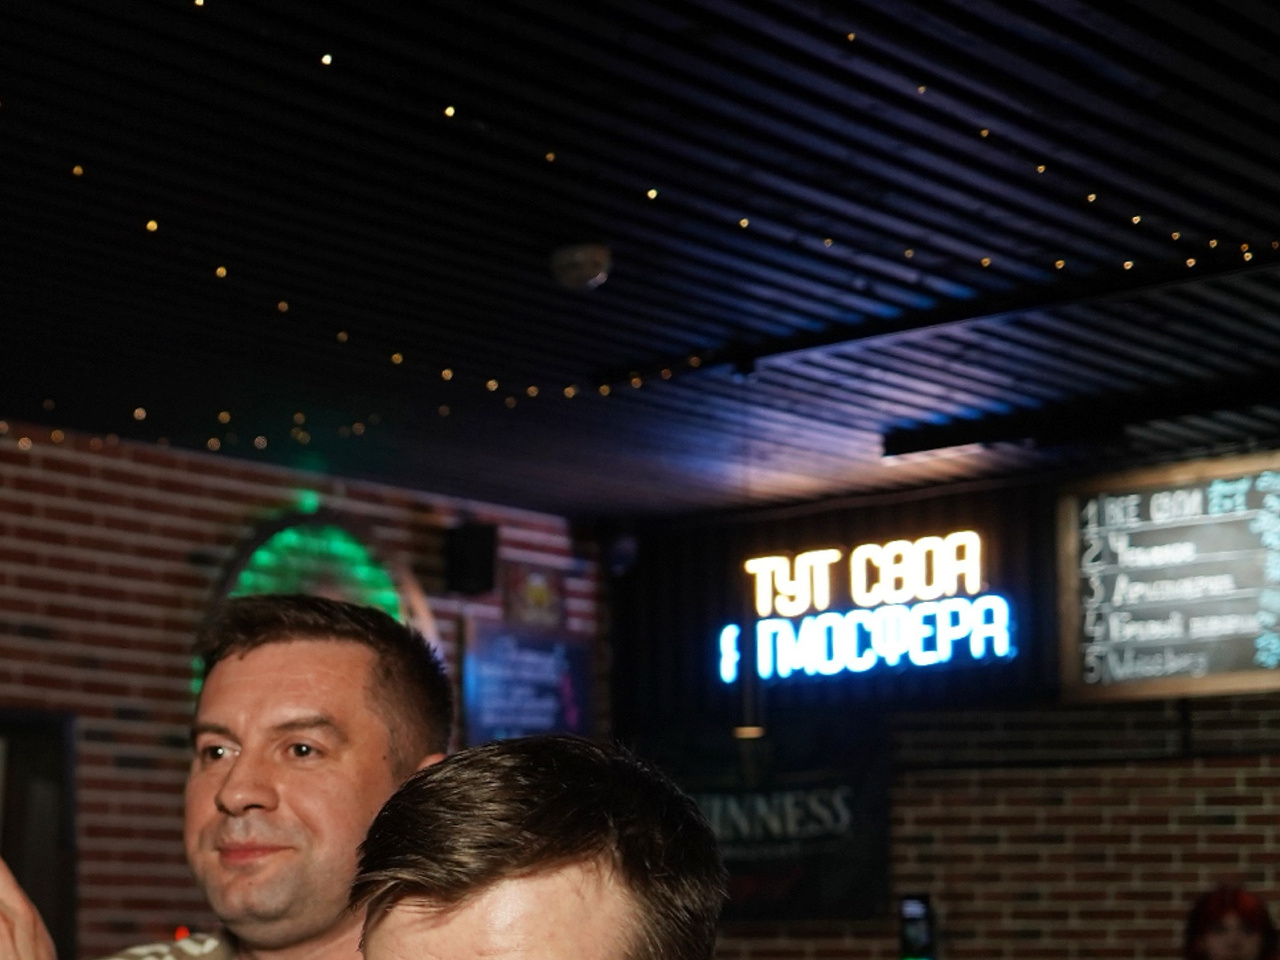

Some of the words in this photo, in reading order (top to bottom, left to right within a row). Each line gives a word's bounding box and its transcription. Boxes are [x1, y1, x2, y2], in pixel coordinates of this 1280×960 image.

[744, 548, 842, 618] ТУТ
[850, 530, 982, 607] СВОЯ
[703, 786, 852, 838] INNESS
